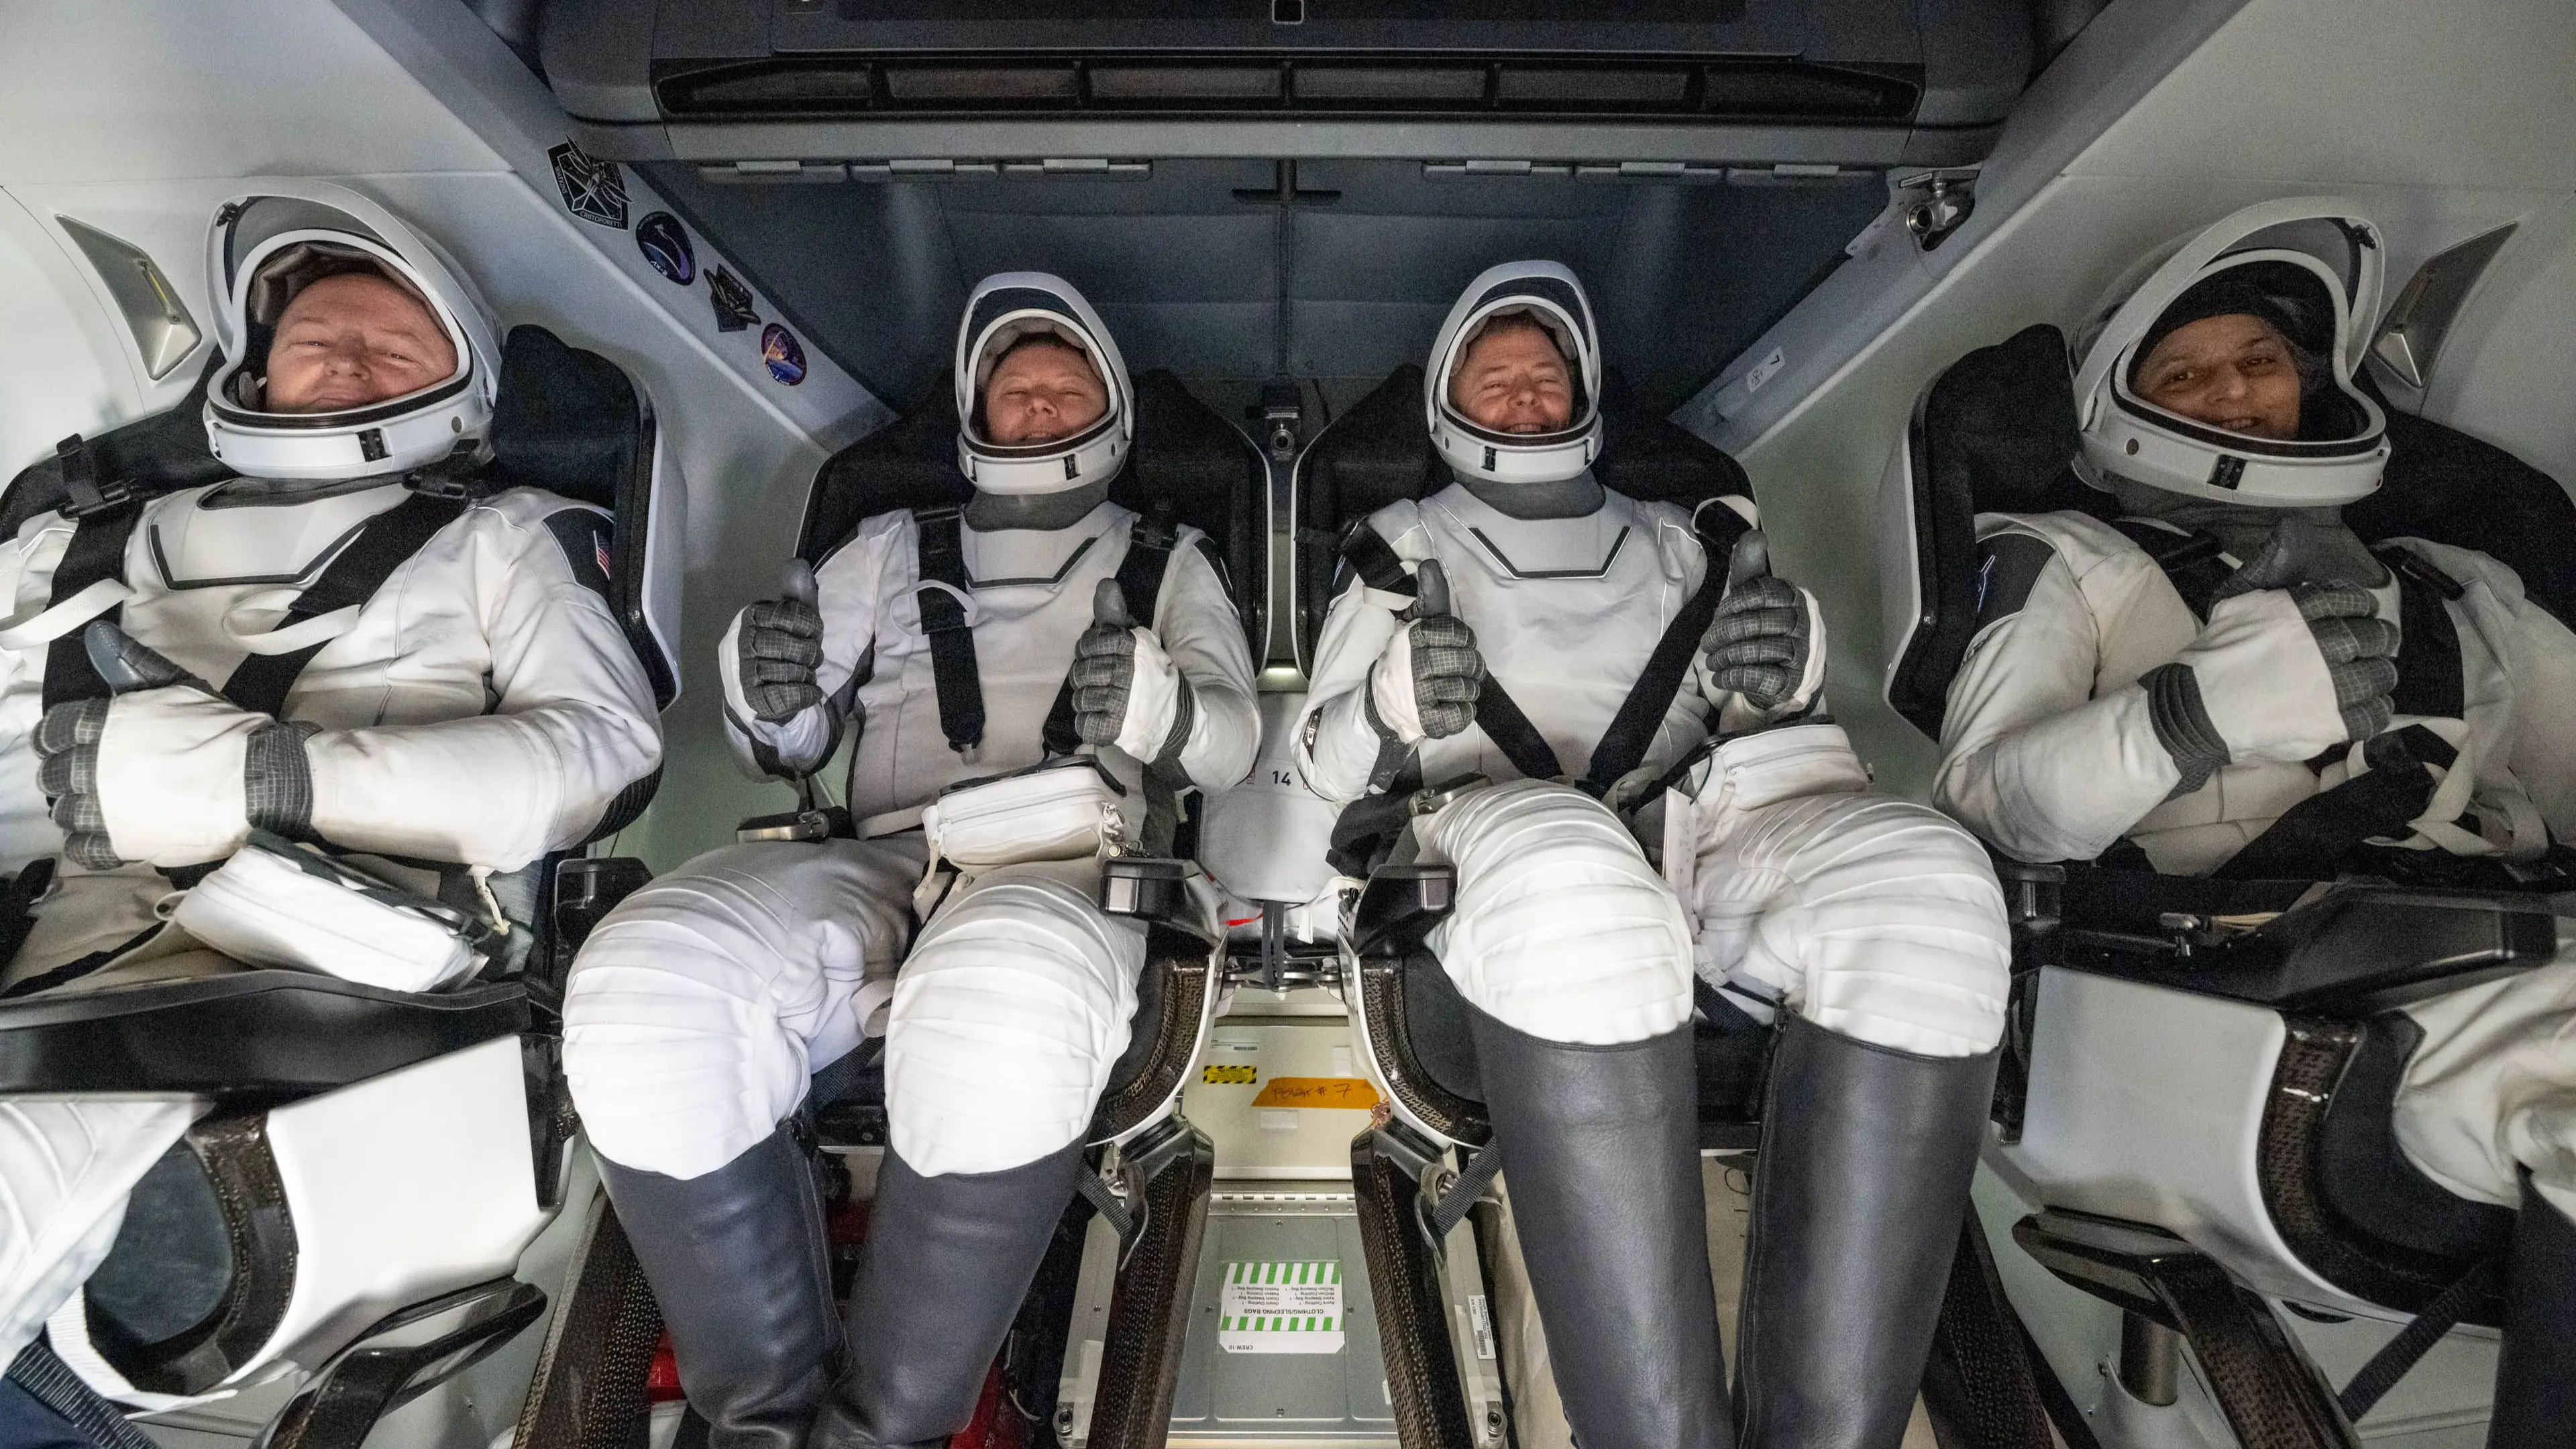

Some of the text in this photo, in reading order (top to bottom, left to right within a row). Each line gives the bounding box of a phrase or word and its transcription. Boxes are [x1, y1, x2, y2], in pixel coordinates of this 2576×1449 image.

[555, 166, 568, 193] WATKINS
[580, 211, 623, 228] CRISTOFORETTI
[1272, 770, 1291, 786] 14
[1273, 1083, 1352, 1100] Polar # 7
